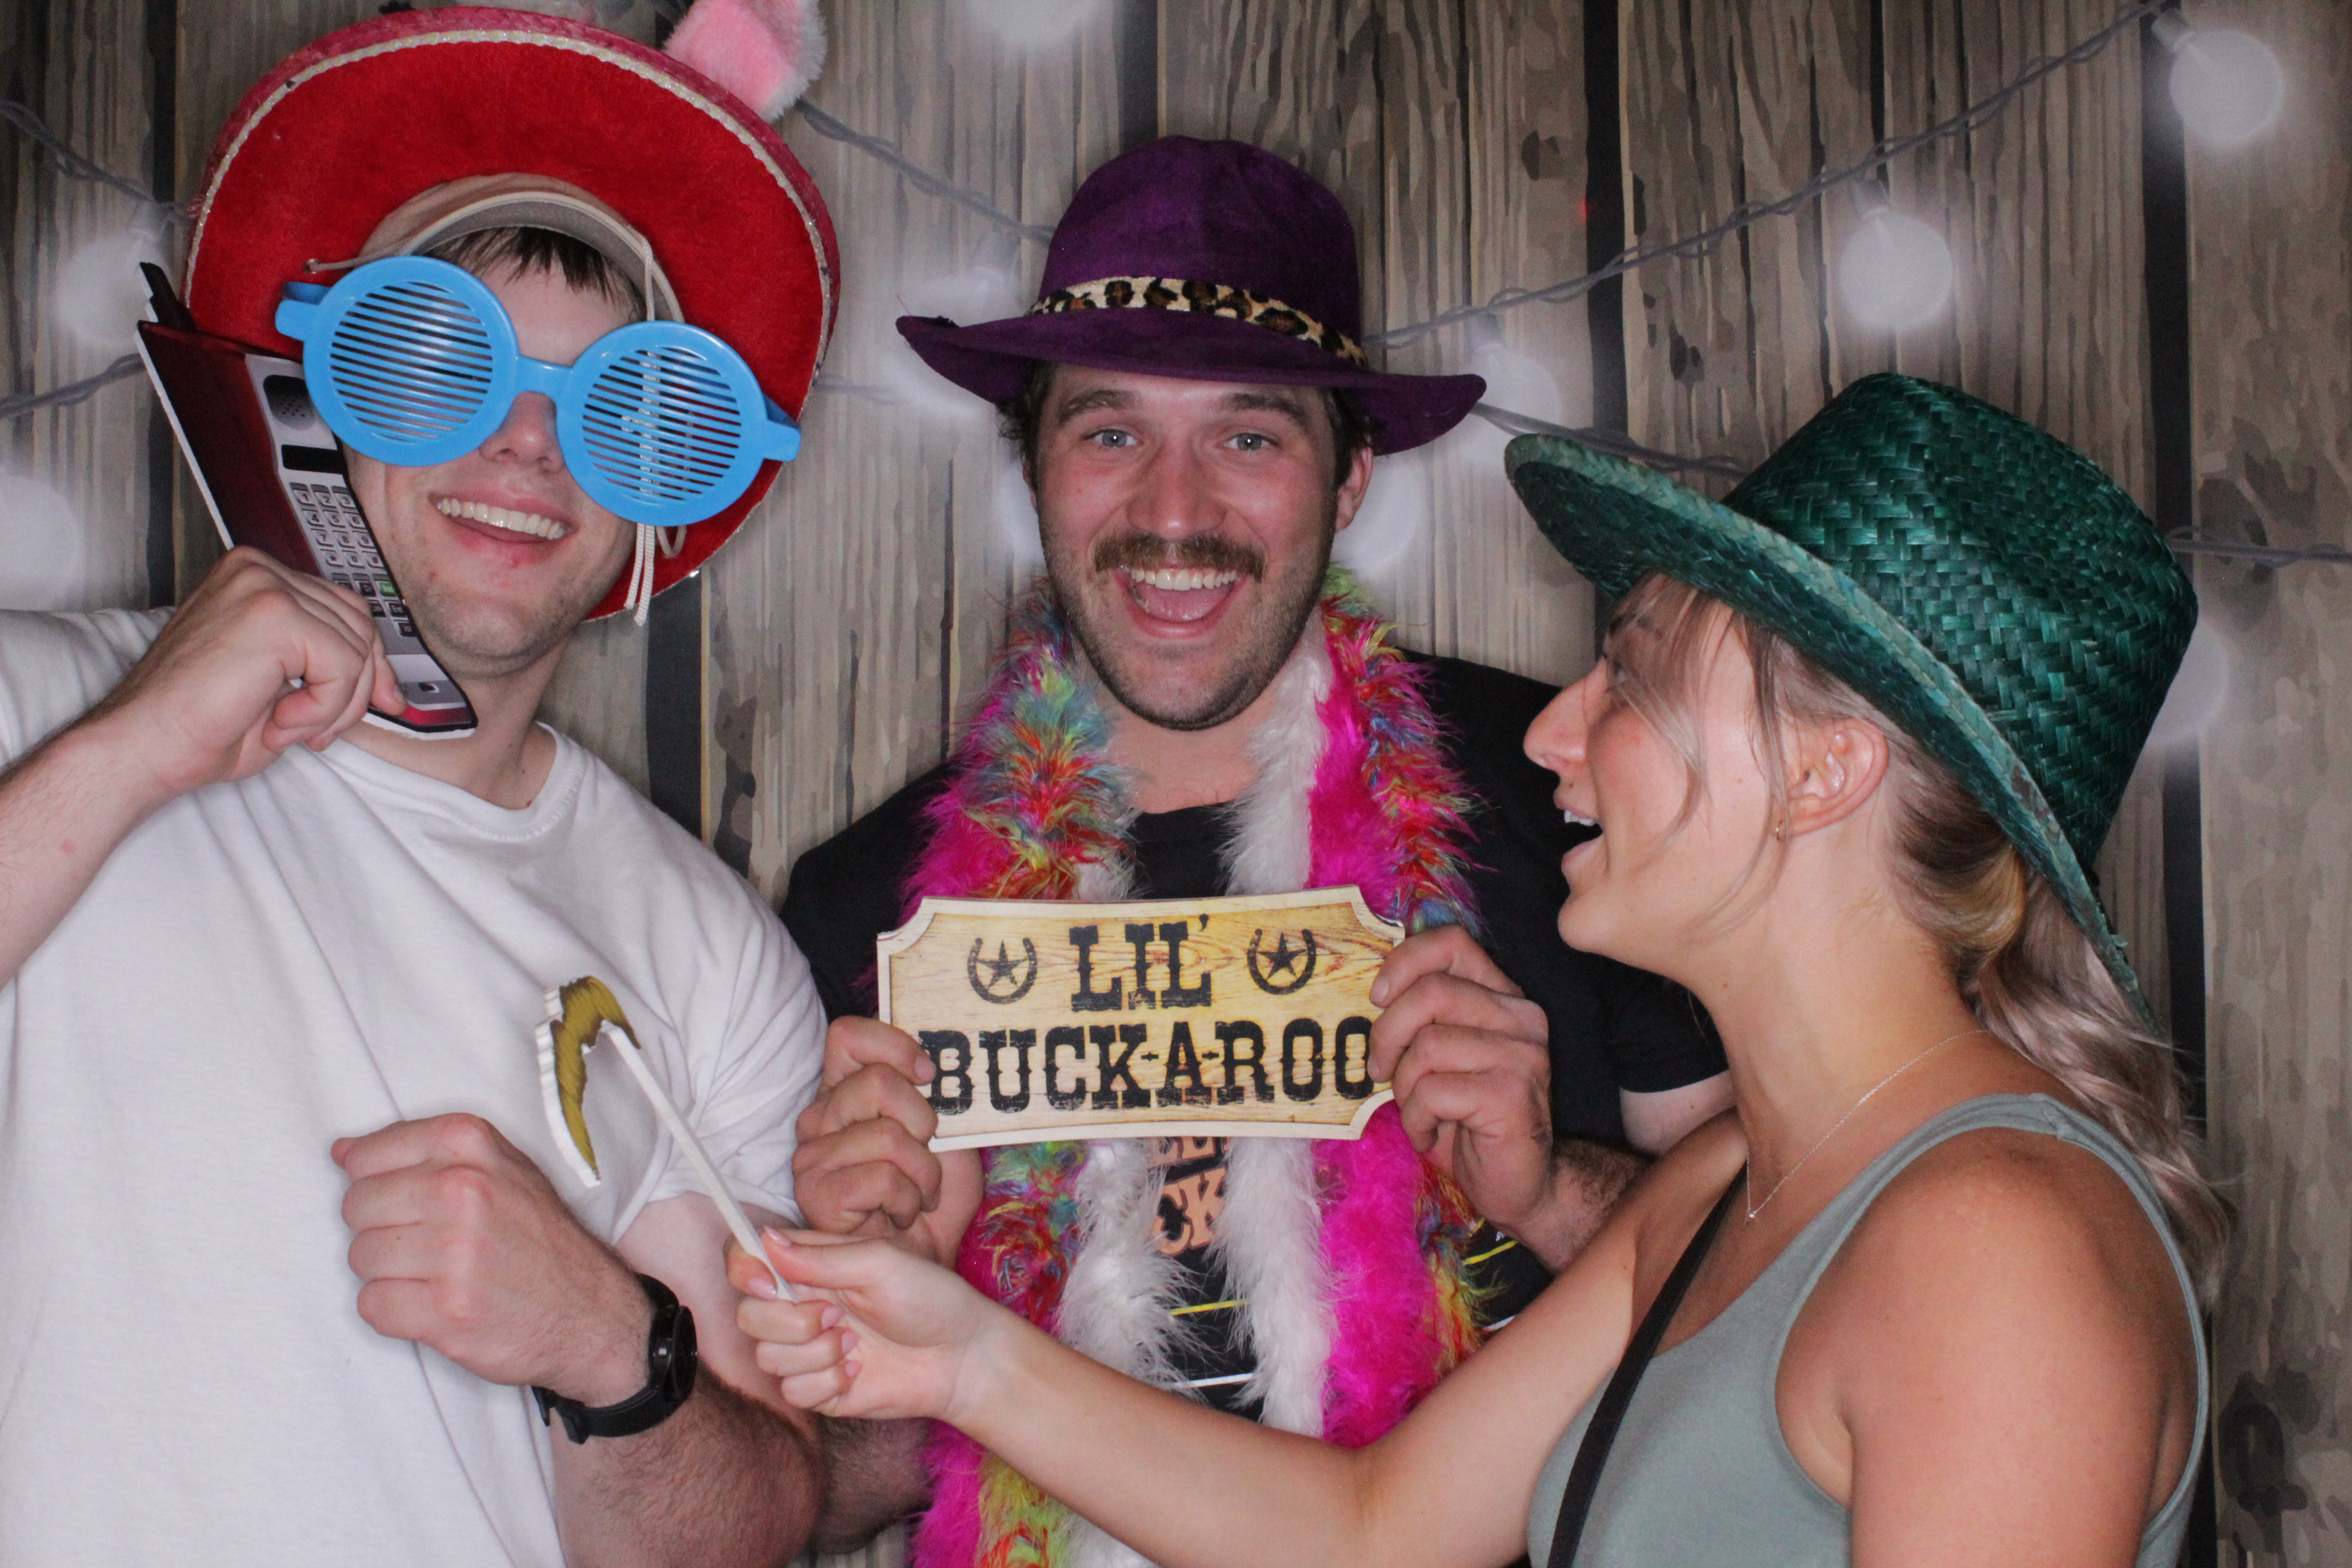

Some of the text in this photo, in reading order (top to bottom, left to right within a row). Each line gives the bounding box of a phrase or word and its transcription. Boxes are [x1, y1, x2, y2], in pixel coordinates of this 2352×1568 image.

[301, 493, 350, 506] 1 2 3
[311, 513, 361, 525] 4 5 6
[320, 534, 370, 545] 7 8 9
[1069, 913, 1211, 1013] LIL'
[918, 1015, 1375, 1115] BUCK-A-ROO
